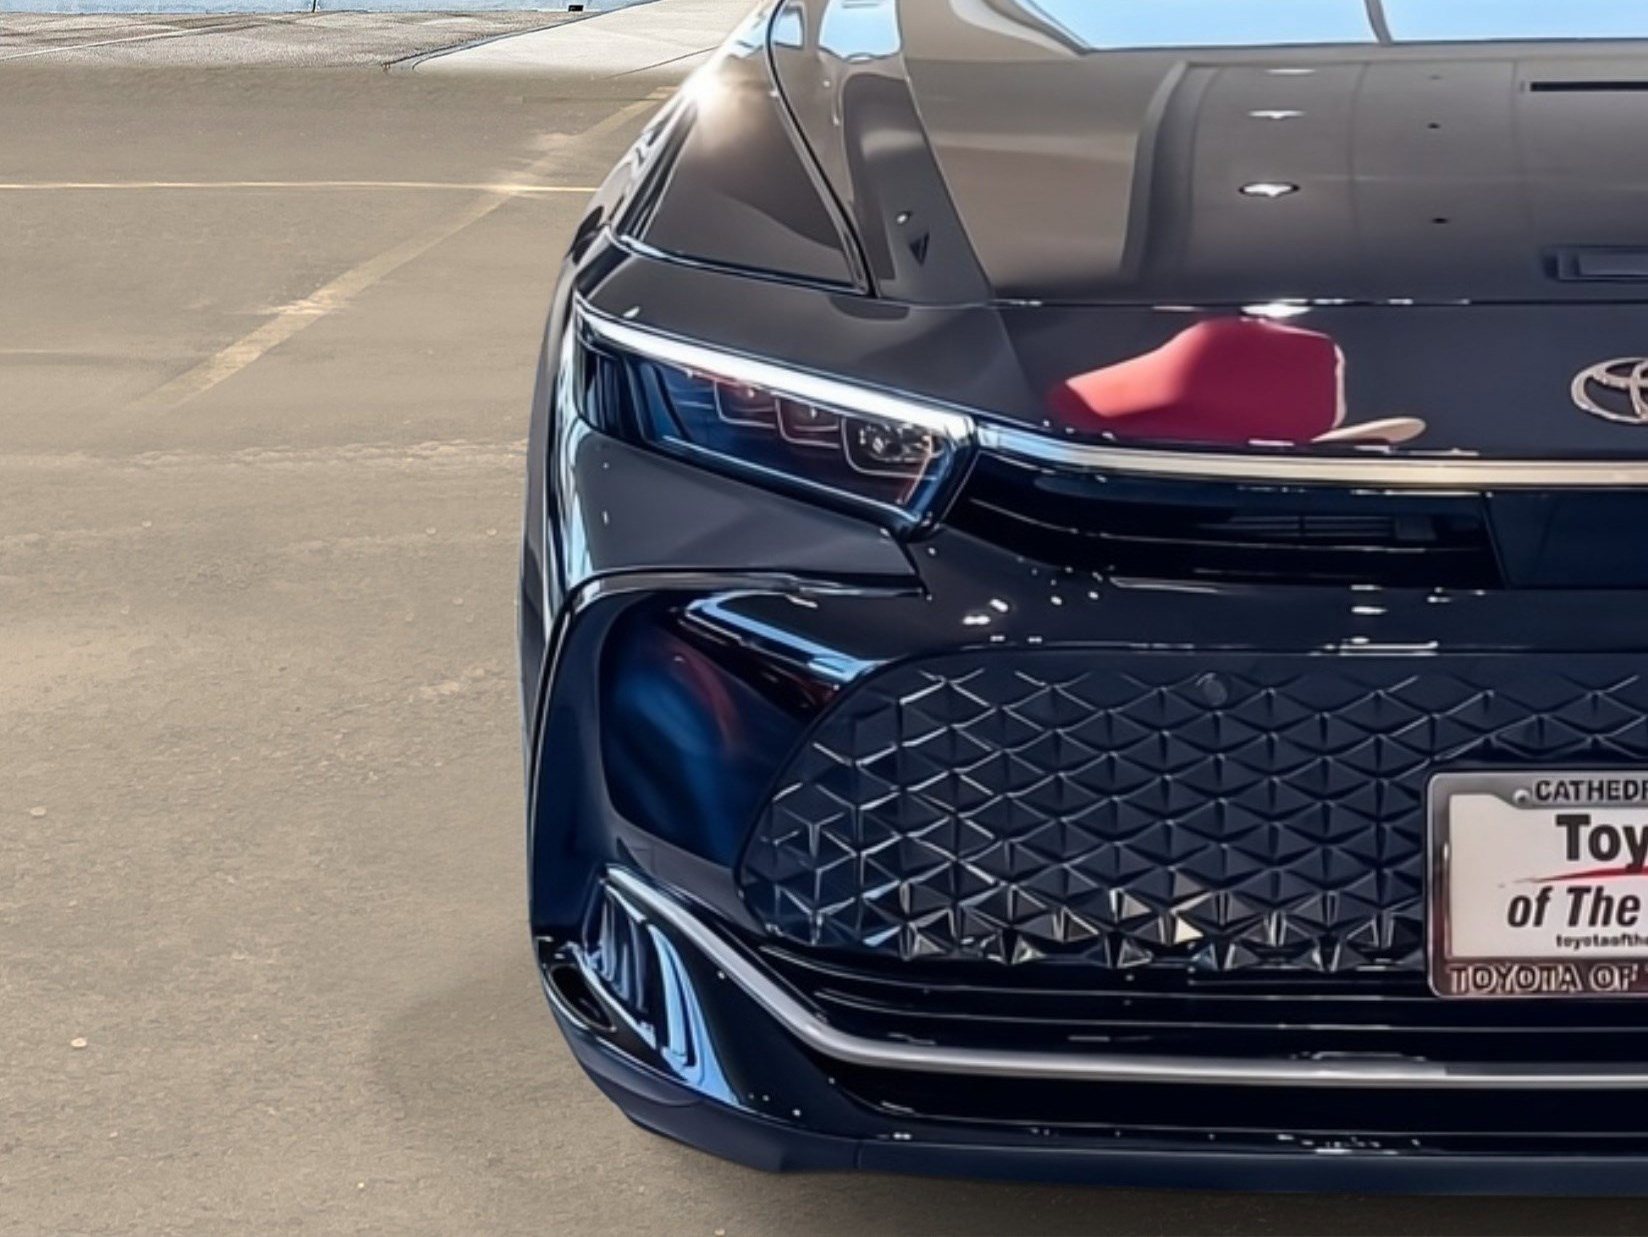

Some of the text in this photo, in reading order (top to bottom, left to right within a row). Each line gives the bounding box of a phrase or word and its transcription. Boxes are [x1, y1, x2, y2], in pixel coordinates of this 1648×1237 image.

[1507, 885, 1553, 928] of
[1566, 885, 1642, 928] The
[1448, 964, 1583, 992] TOYOTA
[1589, 964, 1638, 992] OF
